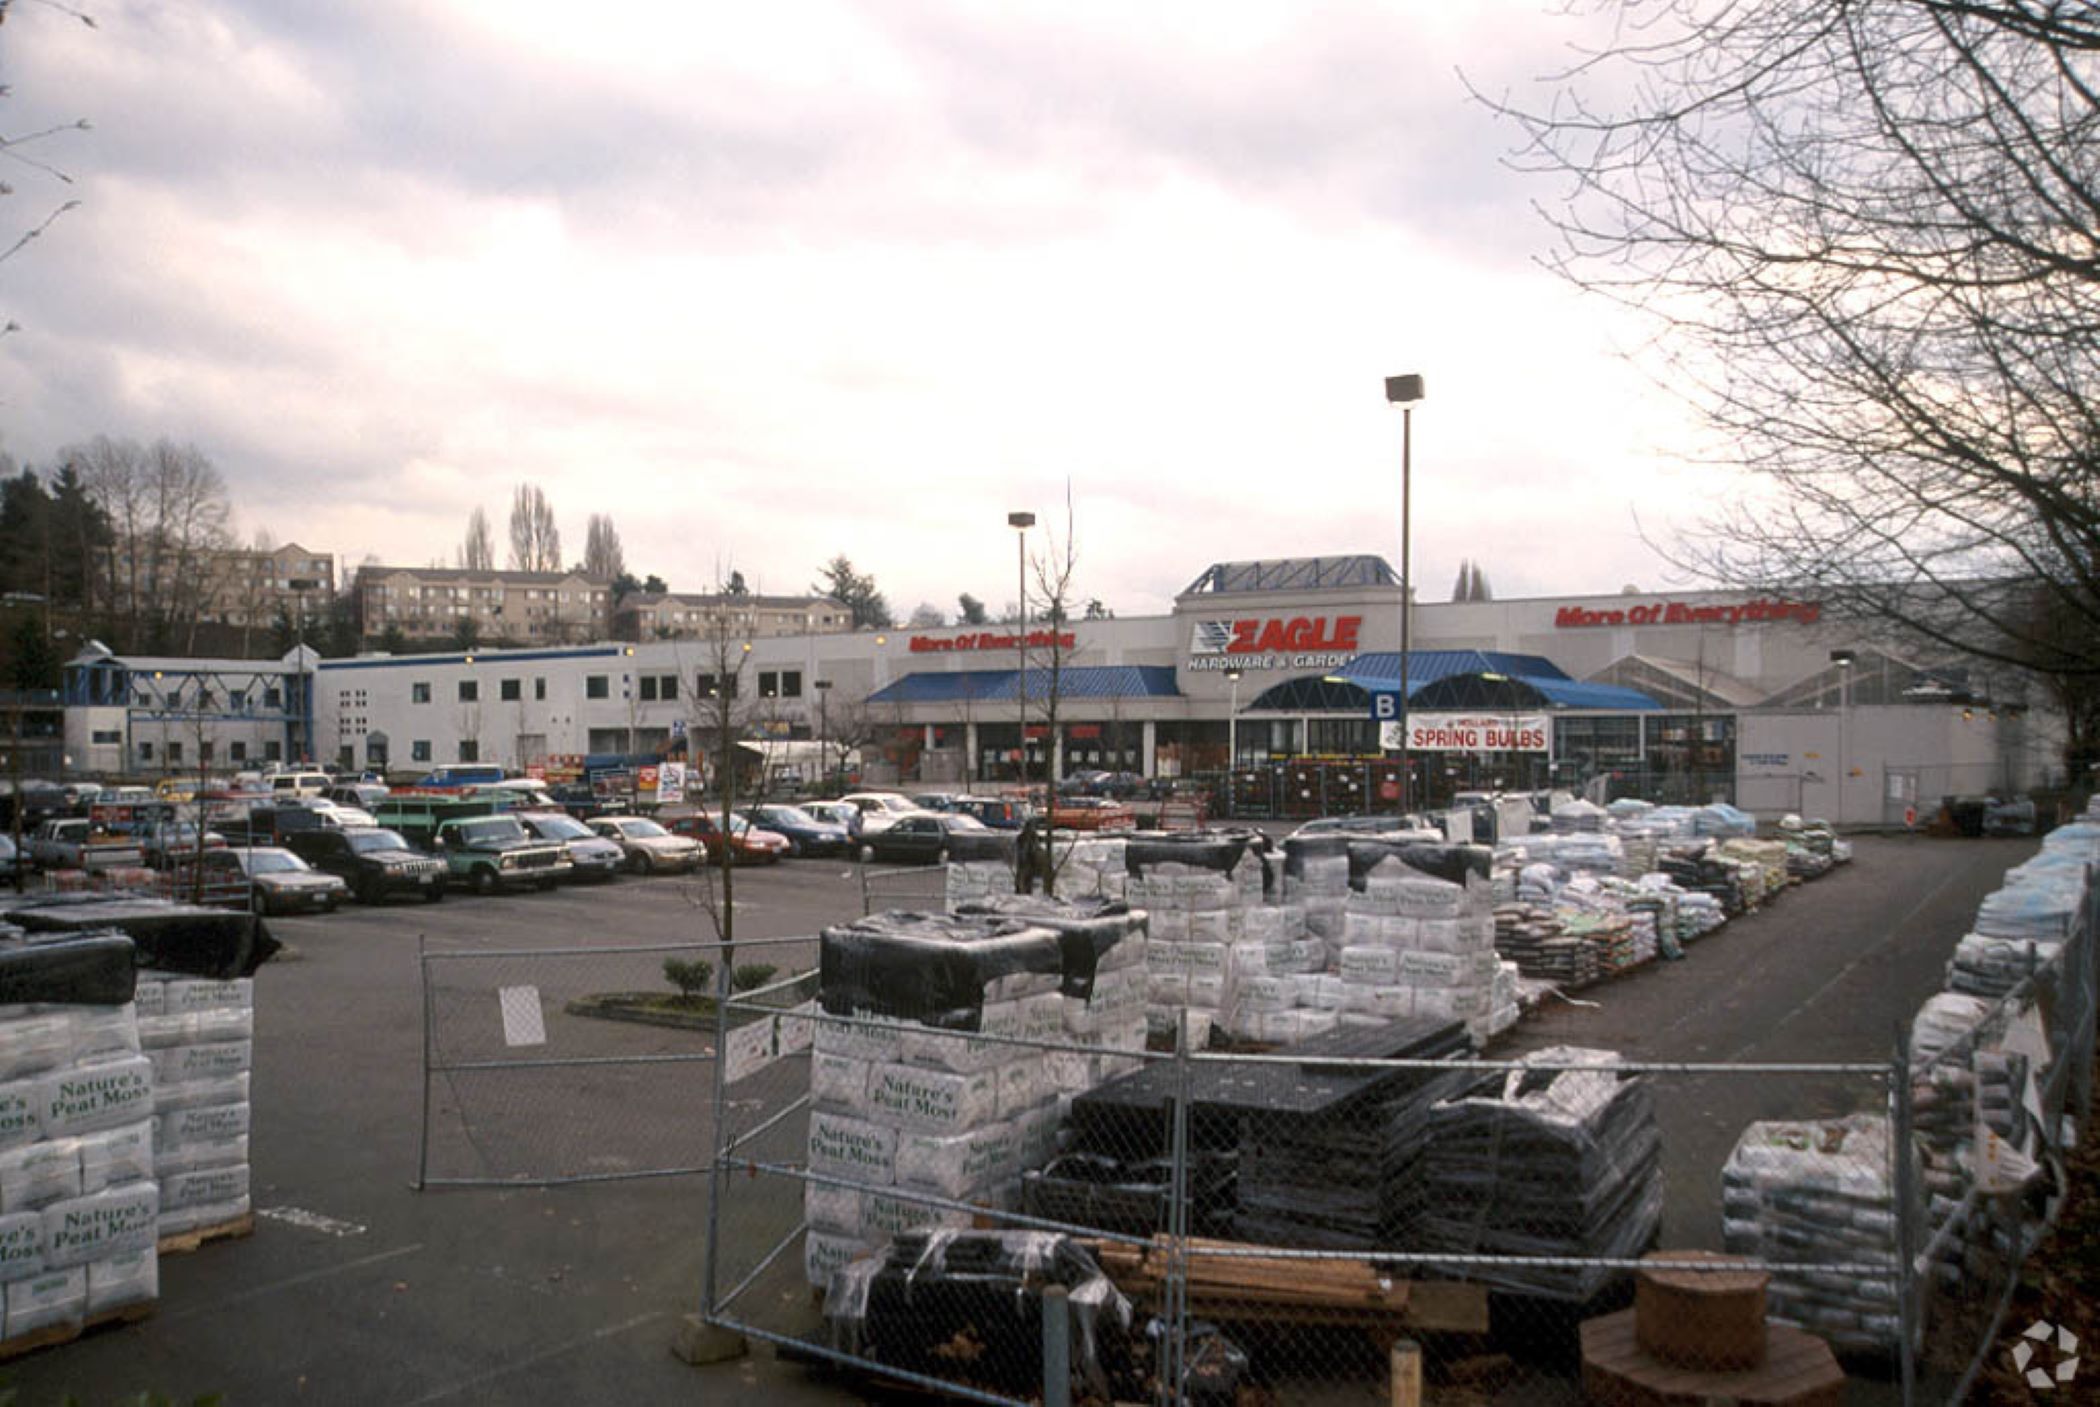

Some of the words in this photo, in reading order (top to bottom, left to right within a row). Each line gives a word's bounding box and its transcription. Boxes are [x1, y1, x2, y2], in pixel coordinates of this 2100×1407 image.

[1554, 607, 1624, 628] More
[1627, 604, 1663, 625] Of
[1663, 597, 1821, 625] Everything
[909, 635, 954, 652] More
[1226, 615, 1362, 653] EAGLE
[1188, 656, 1275, 671] HARDWARE
[1376, 694, 1395, 718] B
[1413, 728, 1478, 747] SPRING
[1485, 728, 1545, 748] BULBS
[59, 1070, 143, 1099] Nature's
[883, 1073, 954, 1103] Nature's
[51, 1097, 97, 1119] Peat
[103, 1086, 150, 1107] Moss
[873, 1088, 909, 1110] Peat
[914, 1097, 957, 1120] Moss
[0, 1114, 36, 1130] oss
[820, 1122, 883, 1151] Nature's
[810, 1136, 844, 1161] Peat
[849, 1147, 890, 1168] Moss
[64, 1202, 150, 1229] Nature's
[54, 1227, 101, 1249] Peat
